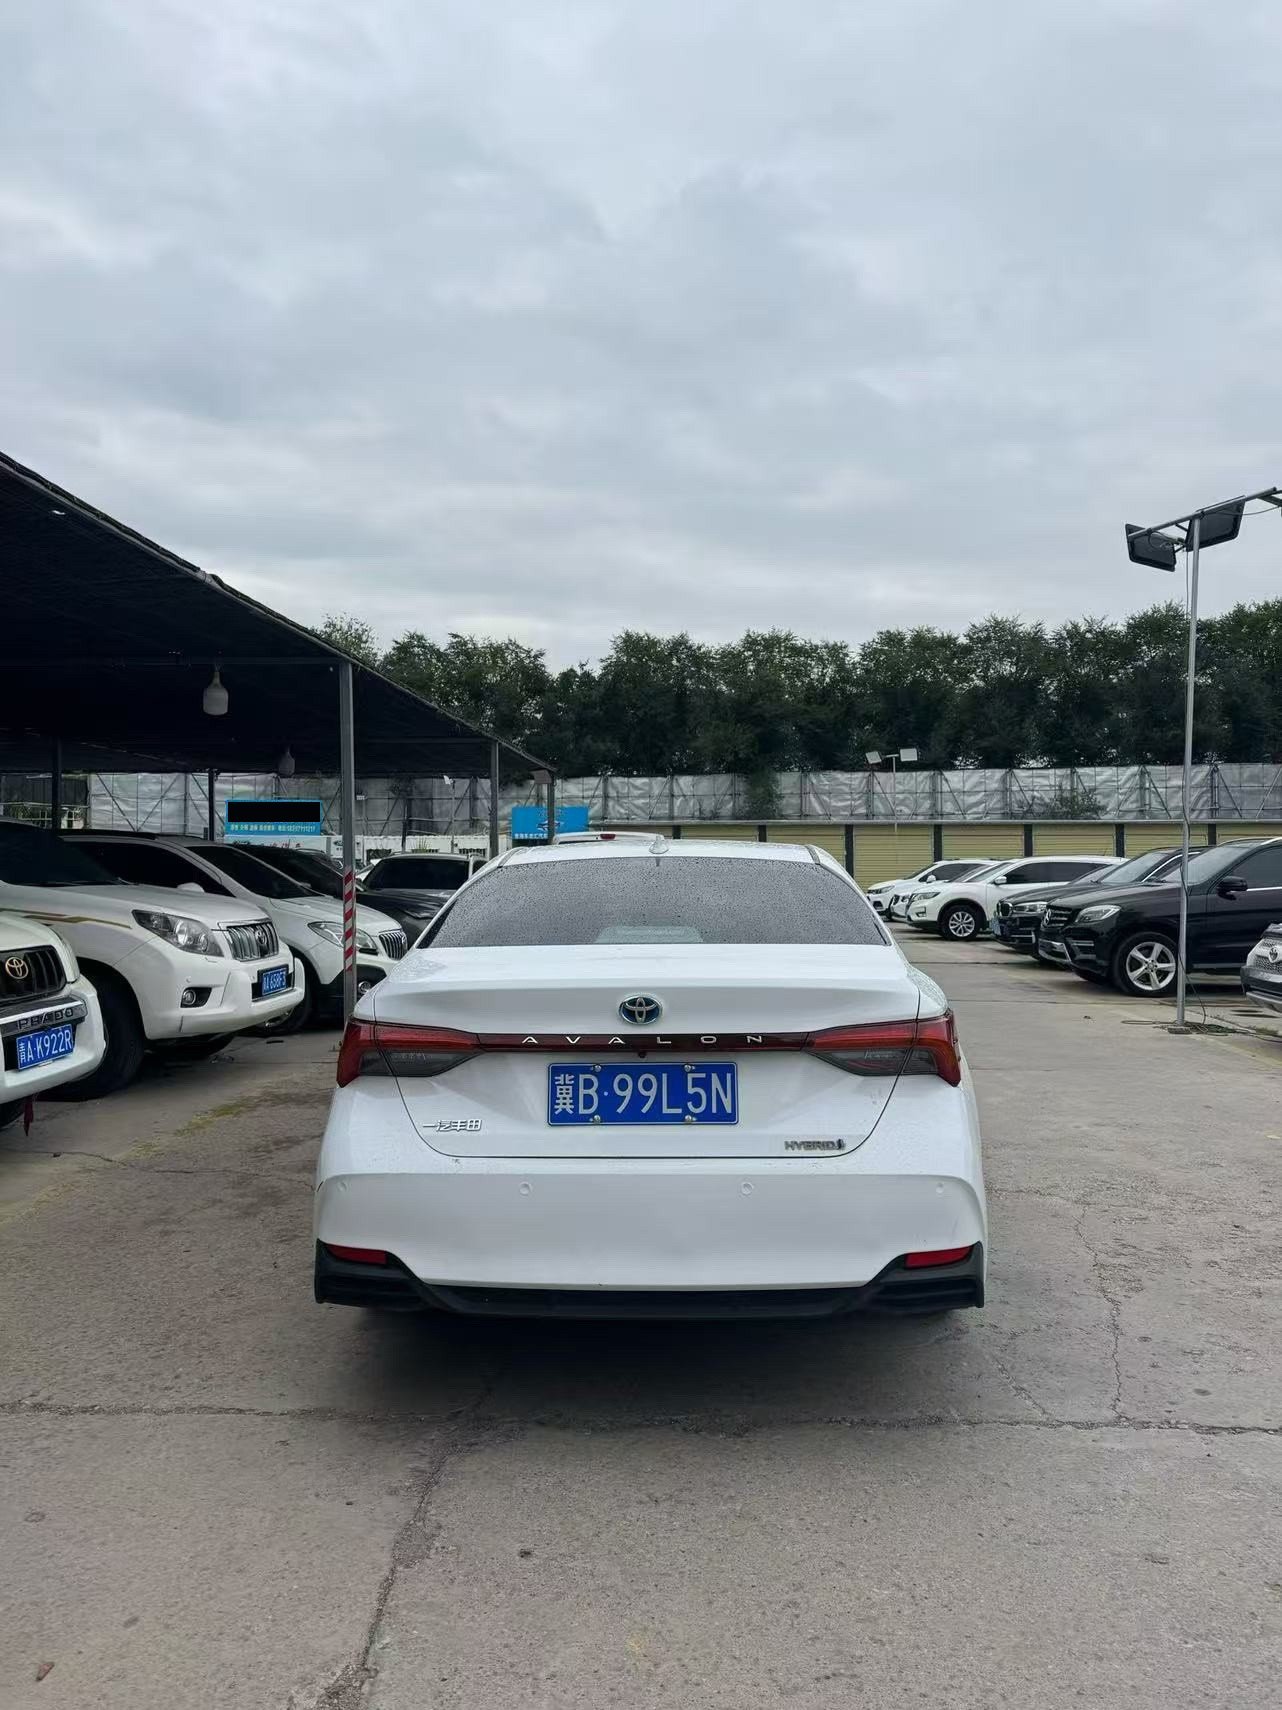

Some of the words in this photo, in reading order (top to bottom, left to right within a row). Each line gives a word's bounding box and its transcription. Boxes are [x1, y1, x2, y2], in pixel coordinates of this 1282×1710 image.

[522, 1035, 762, 1045] AVALON
[422, 1118, 482, 1132] 一汽丰田
[784, 1140, 836, 1151] HYBRID
